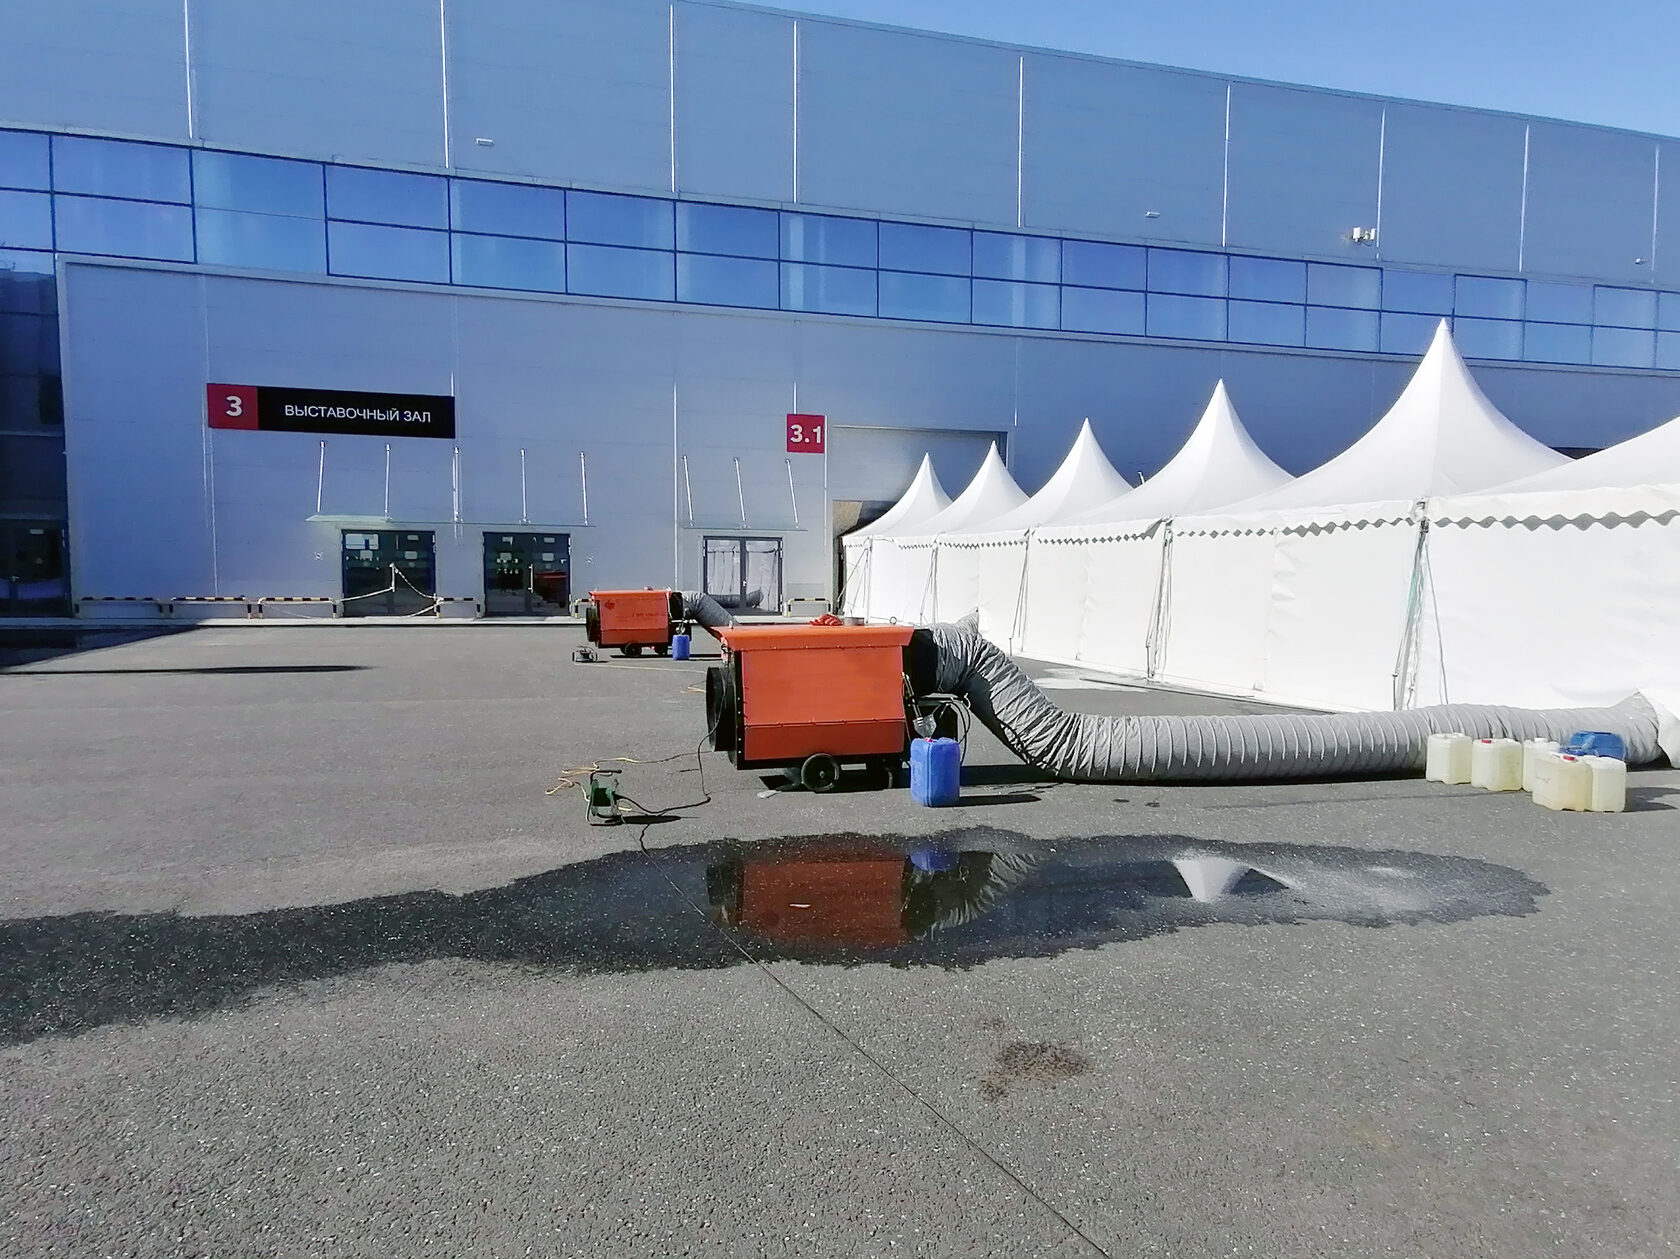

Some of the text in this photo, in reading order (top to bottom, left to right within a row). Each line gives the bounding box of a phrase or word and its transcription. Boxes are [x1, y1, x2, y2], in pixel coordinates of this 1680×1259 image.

[225, 395, 431, 423] 3 ВЫСТАВОЧНЫЙ ЗАЛ
[790, 424, 821, 444] 3.1
